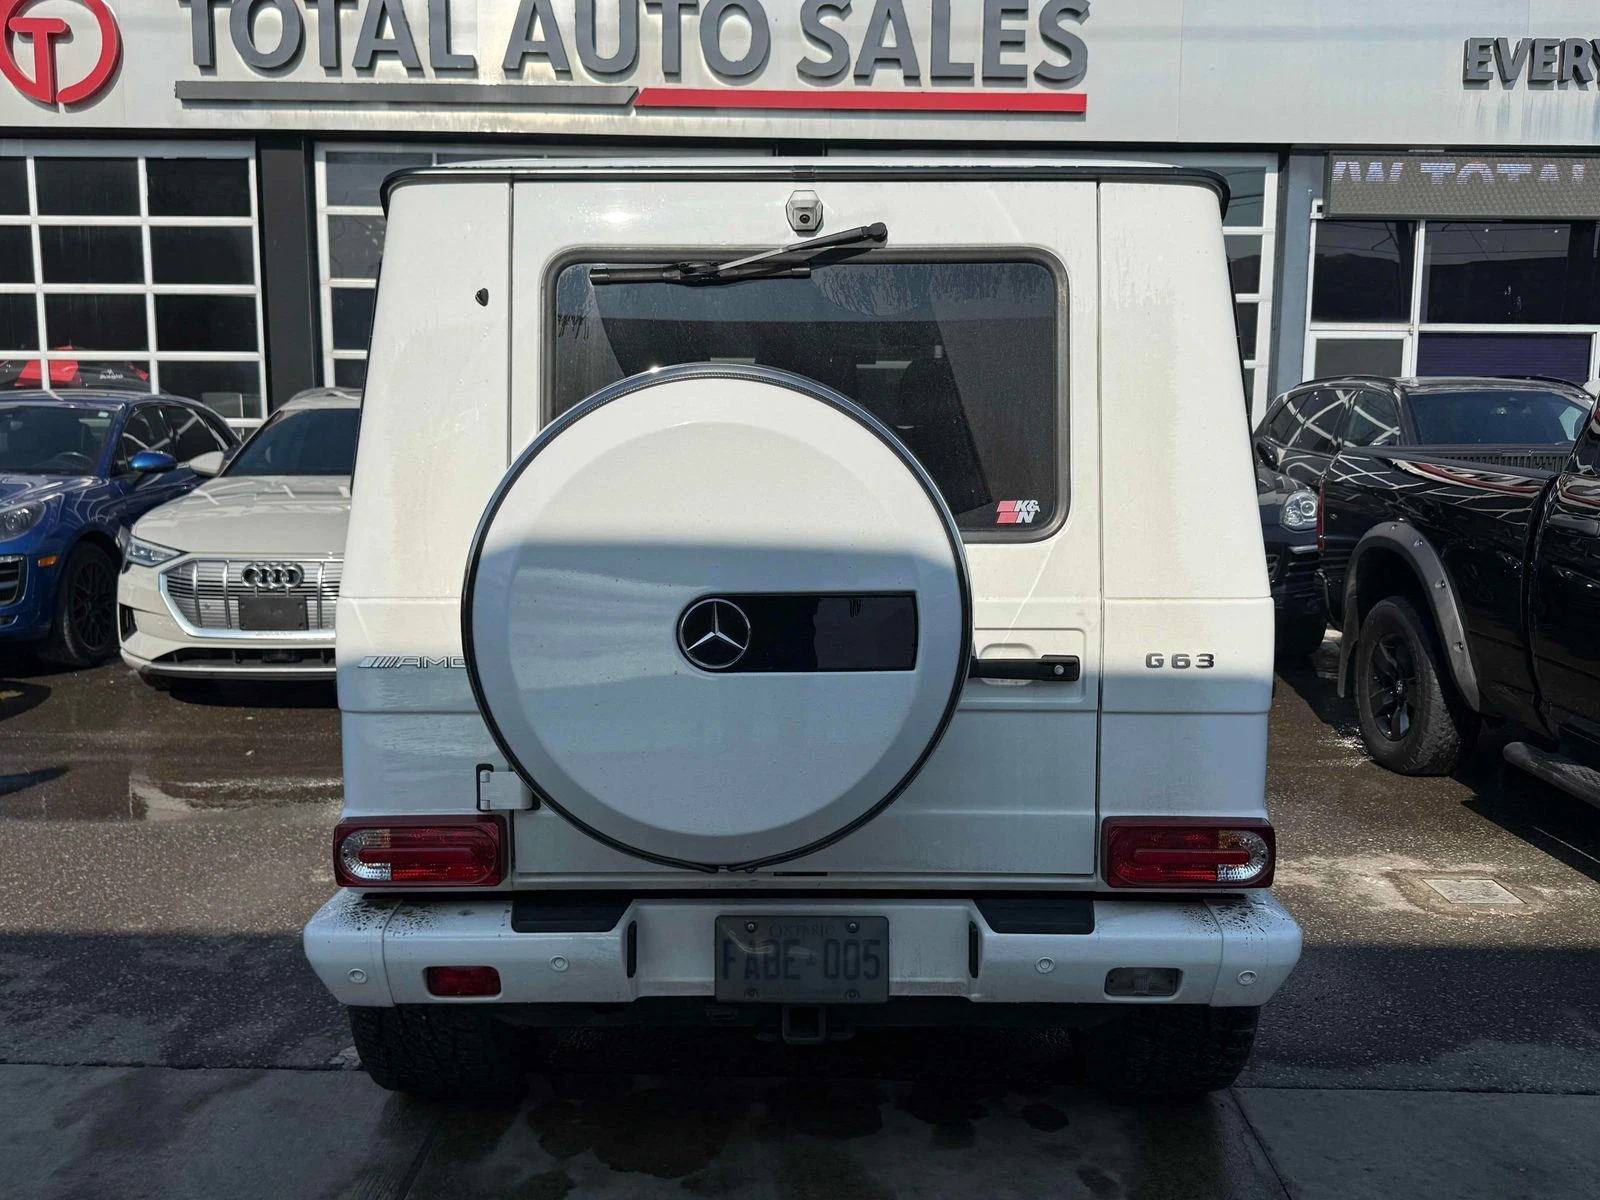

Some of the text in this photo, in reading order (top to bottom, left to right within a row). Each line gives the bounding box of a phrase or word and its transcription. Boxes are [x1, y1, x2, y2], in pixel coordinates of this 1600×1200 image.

[182, 0, 1091, 82] TOTAL AUTO SALES
[1464, 37, 1600, 84] EVER
